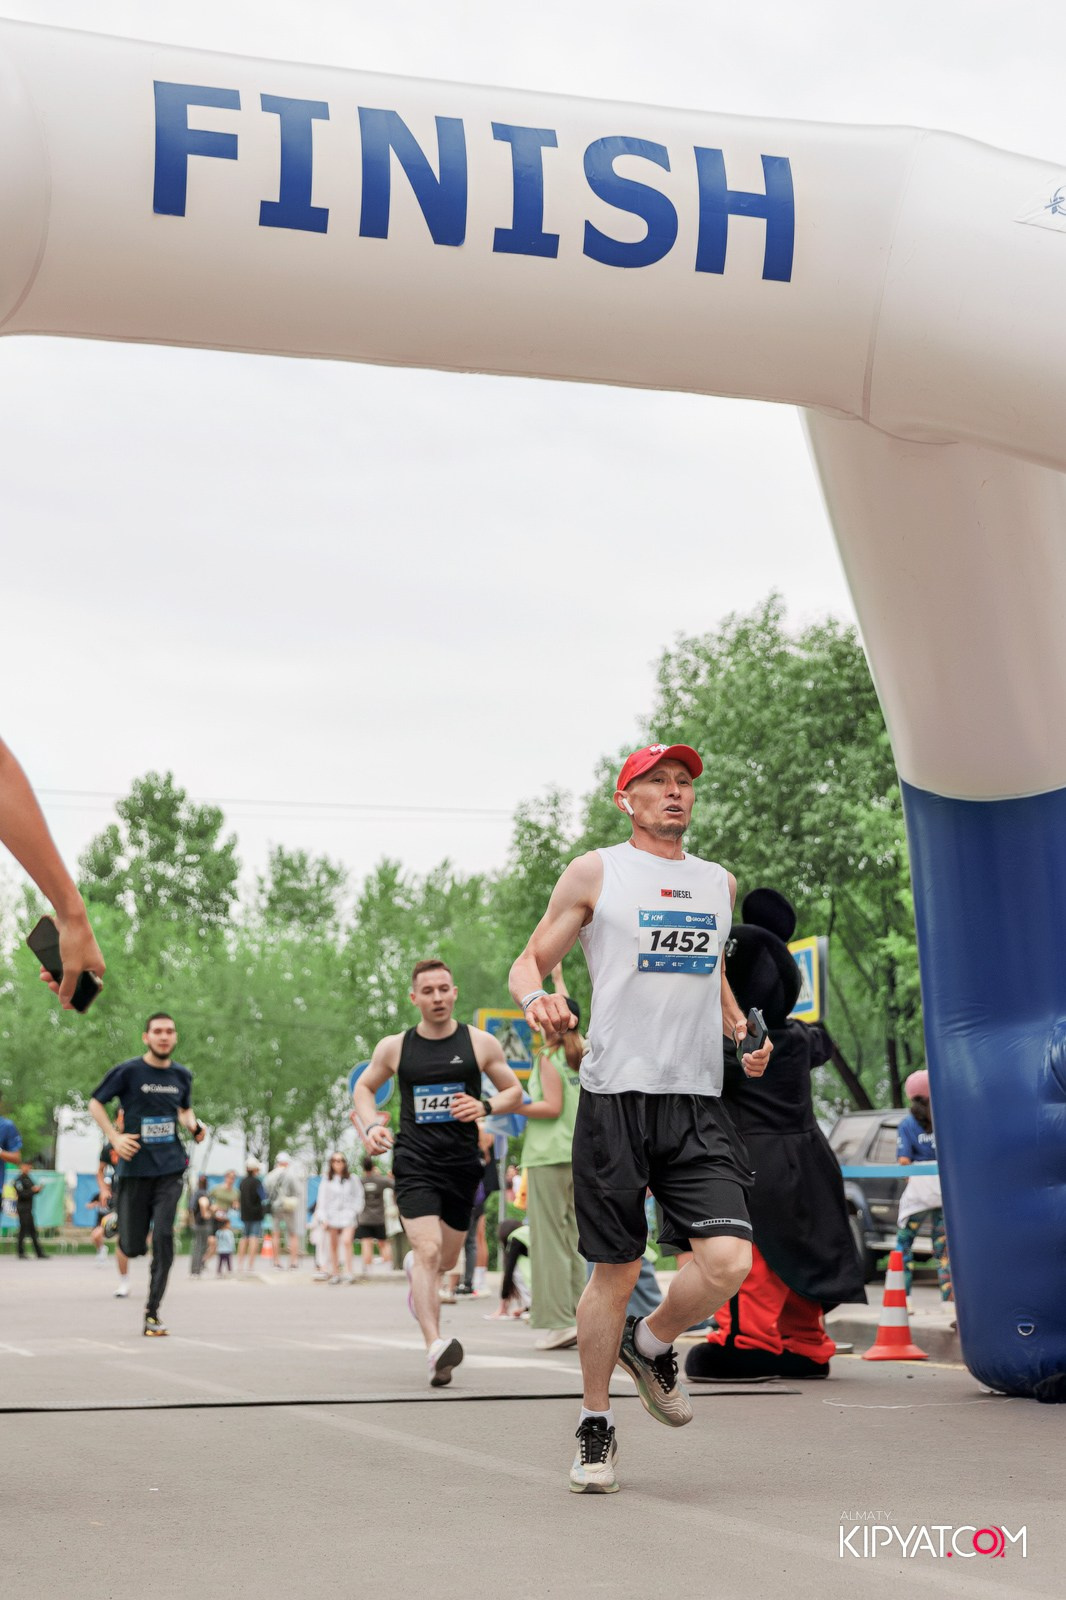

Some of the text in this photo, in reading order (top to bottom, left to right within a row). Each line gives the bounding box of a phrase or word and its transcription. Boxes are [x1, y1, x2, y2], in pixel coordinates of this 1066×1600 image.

[153, 80, 796, 283] FINISH
[672, 889, 692, 899] DIESEL
[642, 913, 650, 921] 5
[650, 930, 710, 953] 1452
[421, 1096, 457, 1111] 144
